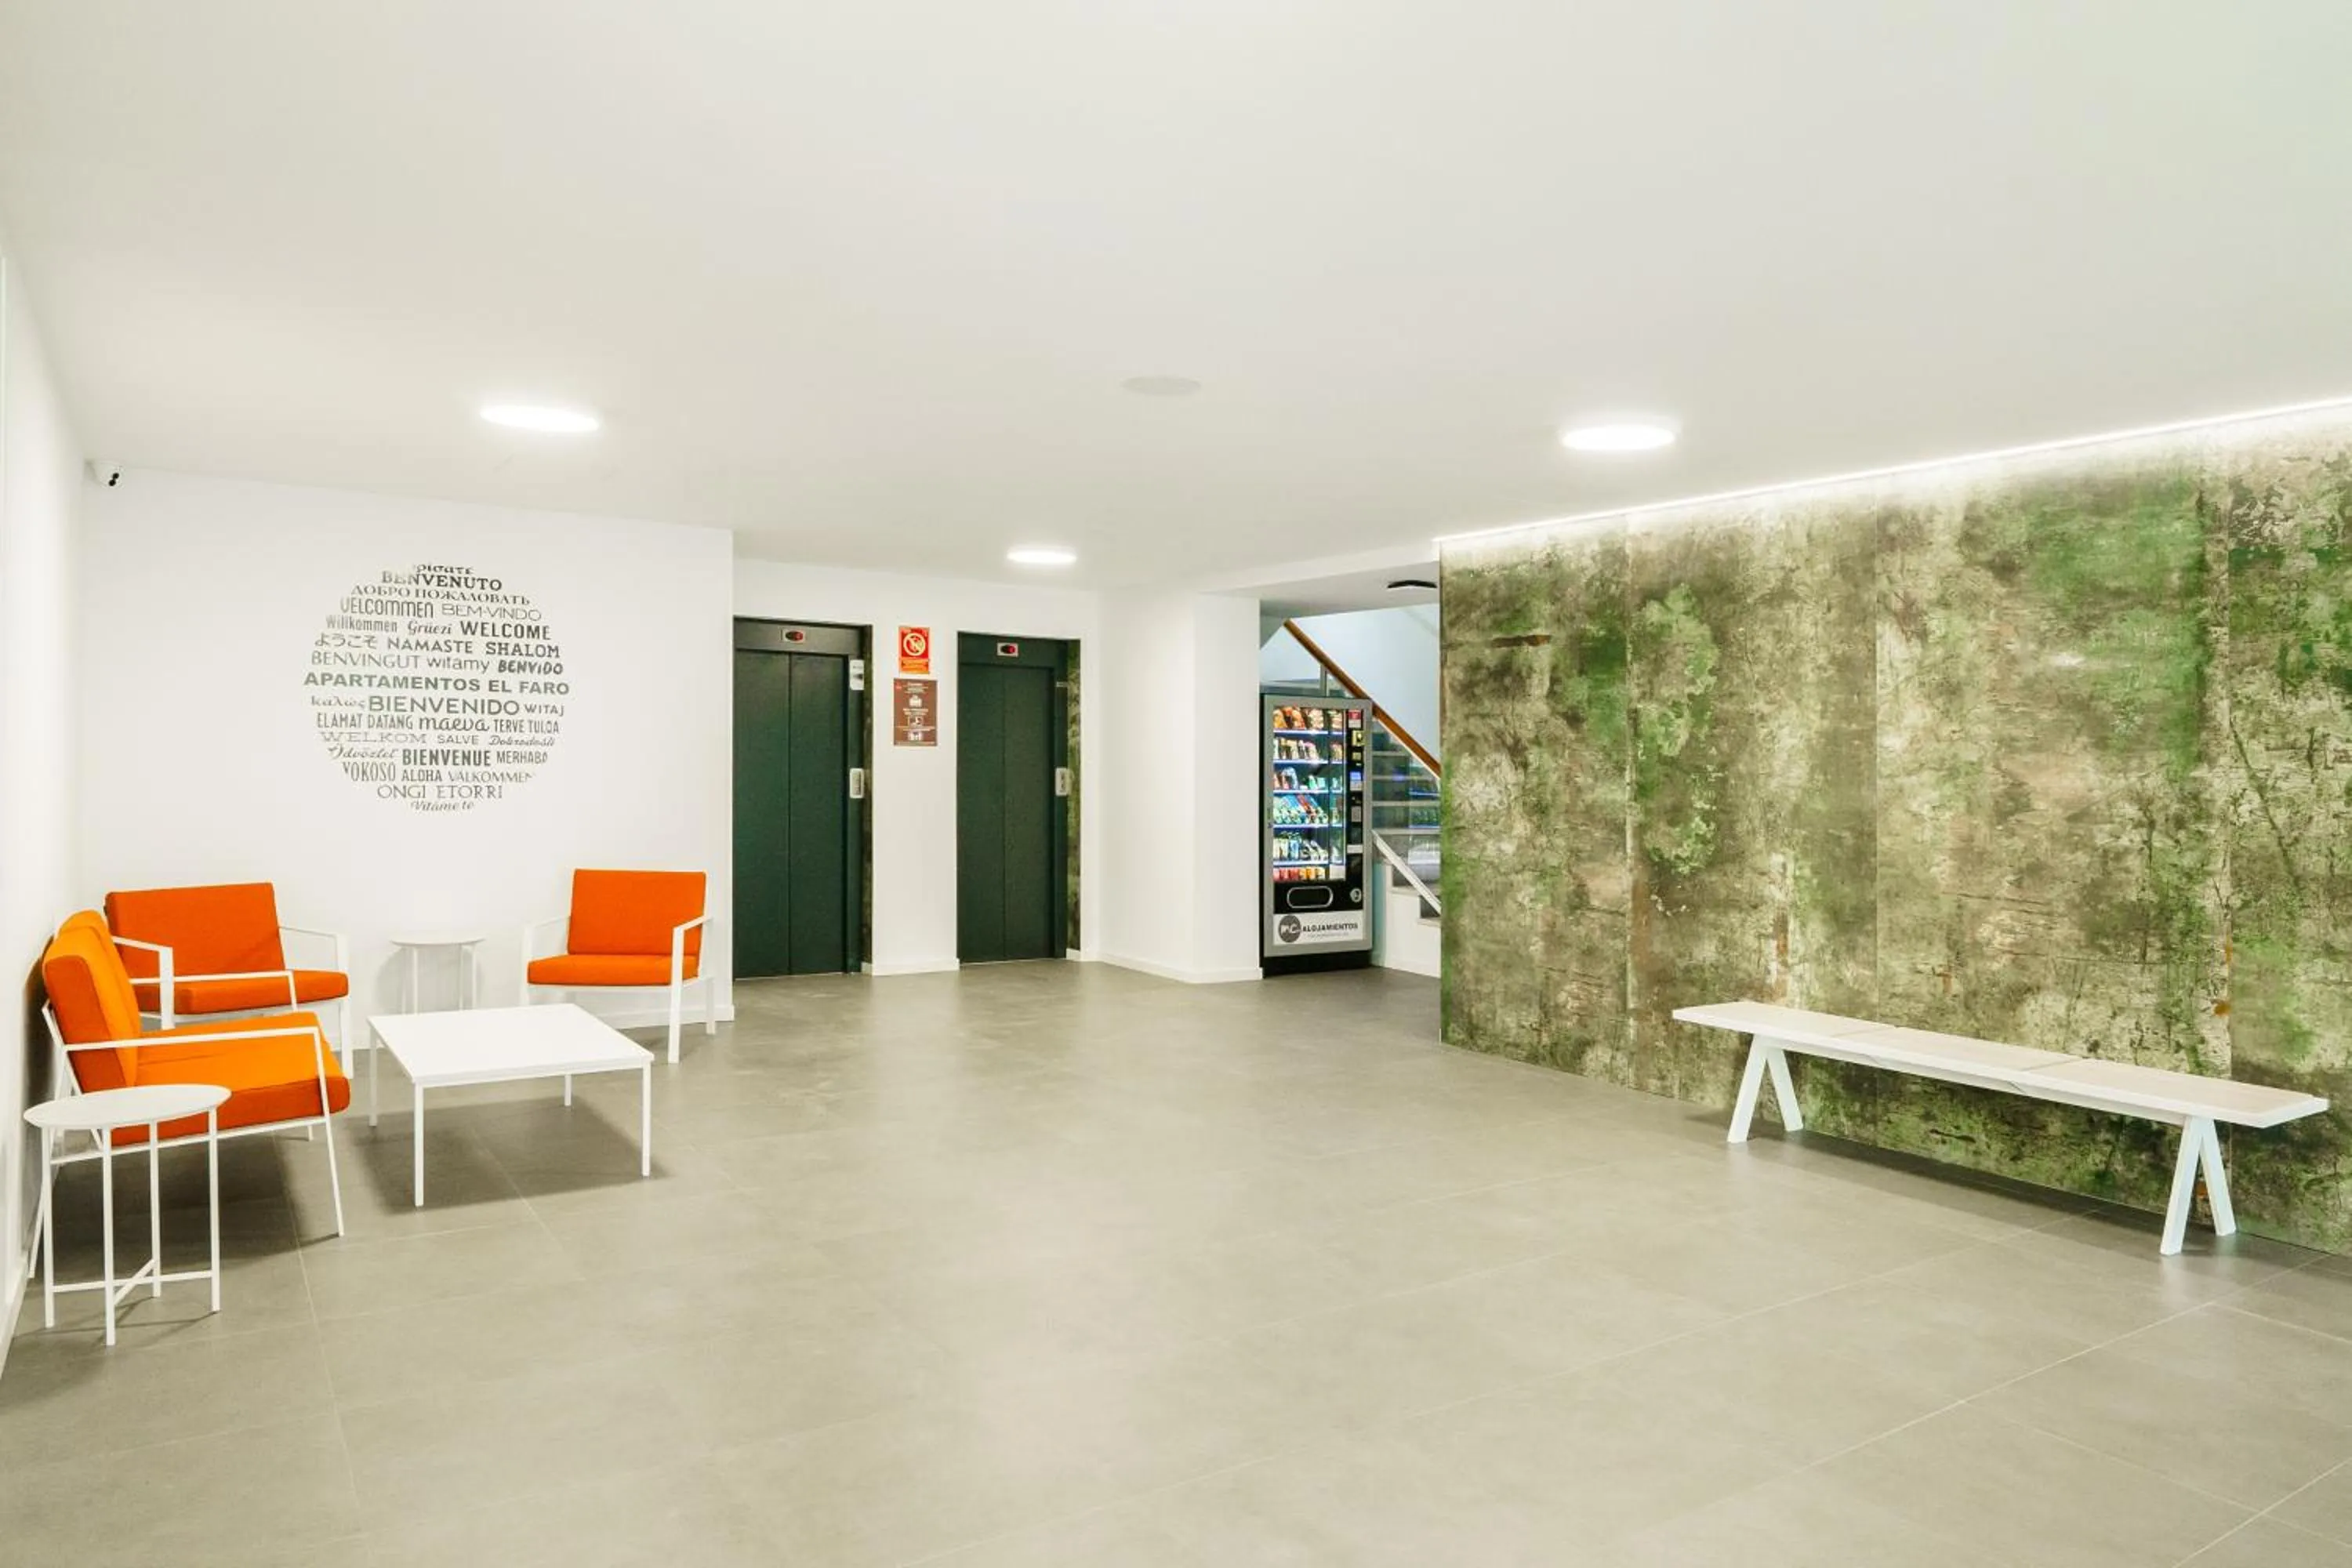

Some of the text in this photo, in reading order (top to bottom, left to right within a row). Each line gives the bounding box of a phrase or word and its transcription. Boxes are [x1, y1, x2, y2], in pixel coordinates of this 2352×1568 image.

[383, 571, 502, 591] BENVENUTO
[416, 589, 529, 605] ПОЖАЛОВАТЬ
[442, 604, 542, 620] BEM-VINDO
[325, 615, 397, 633] Willkommen
[460, 621, 550, 640] WELCOME
[314, 633, 560, 658] ようこそ NAMASTE SHALOM
[311, 650, 421, 670] BENVINGUT
[303, 672, 569, 695] APARTAMENTOS EL FARO
[369, 695, 519, 716] BIENVENIDO
[524, 704, 564, 717] WITAJ
[317, 713, 362, 728] ELAMAT
[368, 714, 412, 730] DATANG
[419, 717, 490, 731] maeva
[494, 719, 524, 733] TERVE
[321, 731, 427, 743] WELKOM
[437, 735, 478, 745] SALVE
[402, 750, 491, 766] BIENVENUE
[401, 770, 442, 782] ALOHA
[377, 785, 502, 799] ONGI ETORRI
